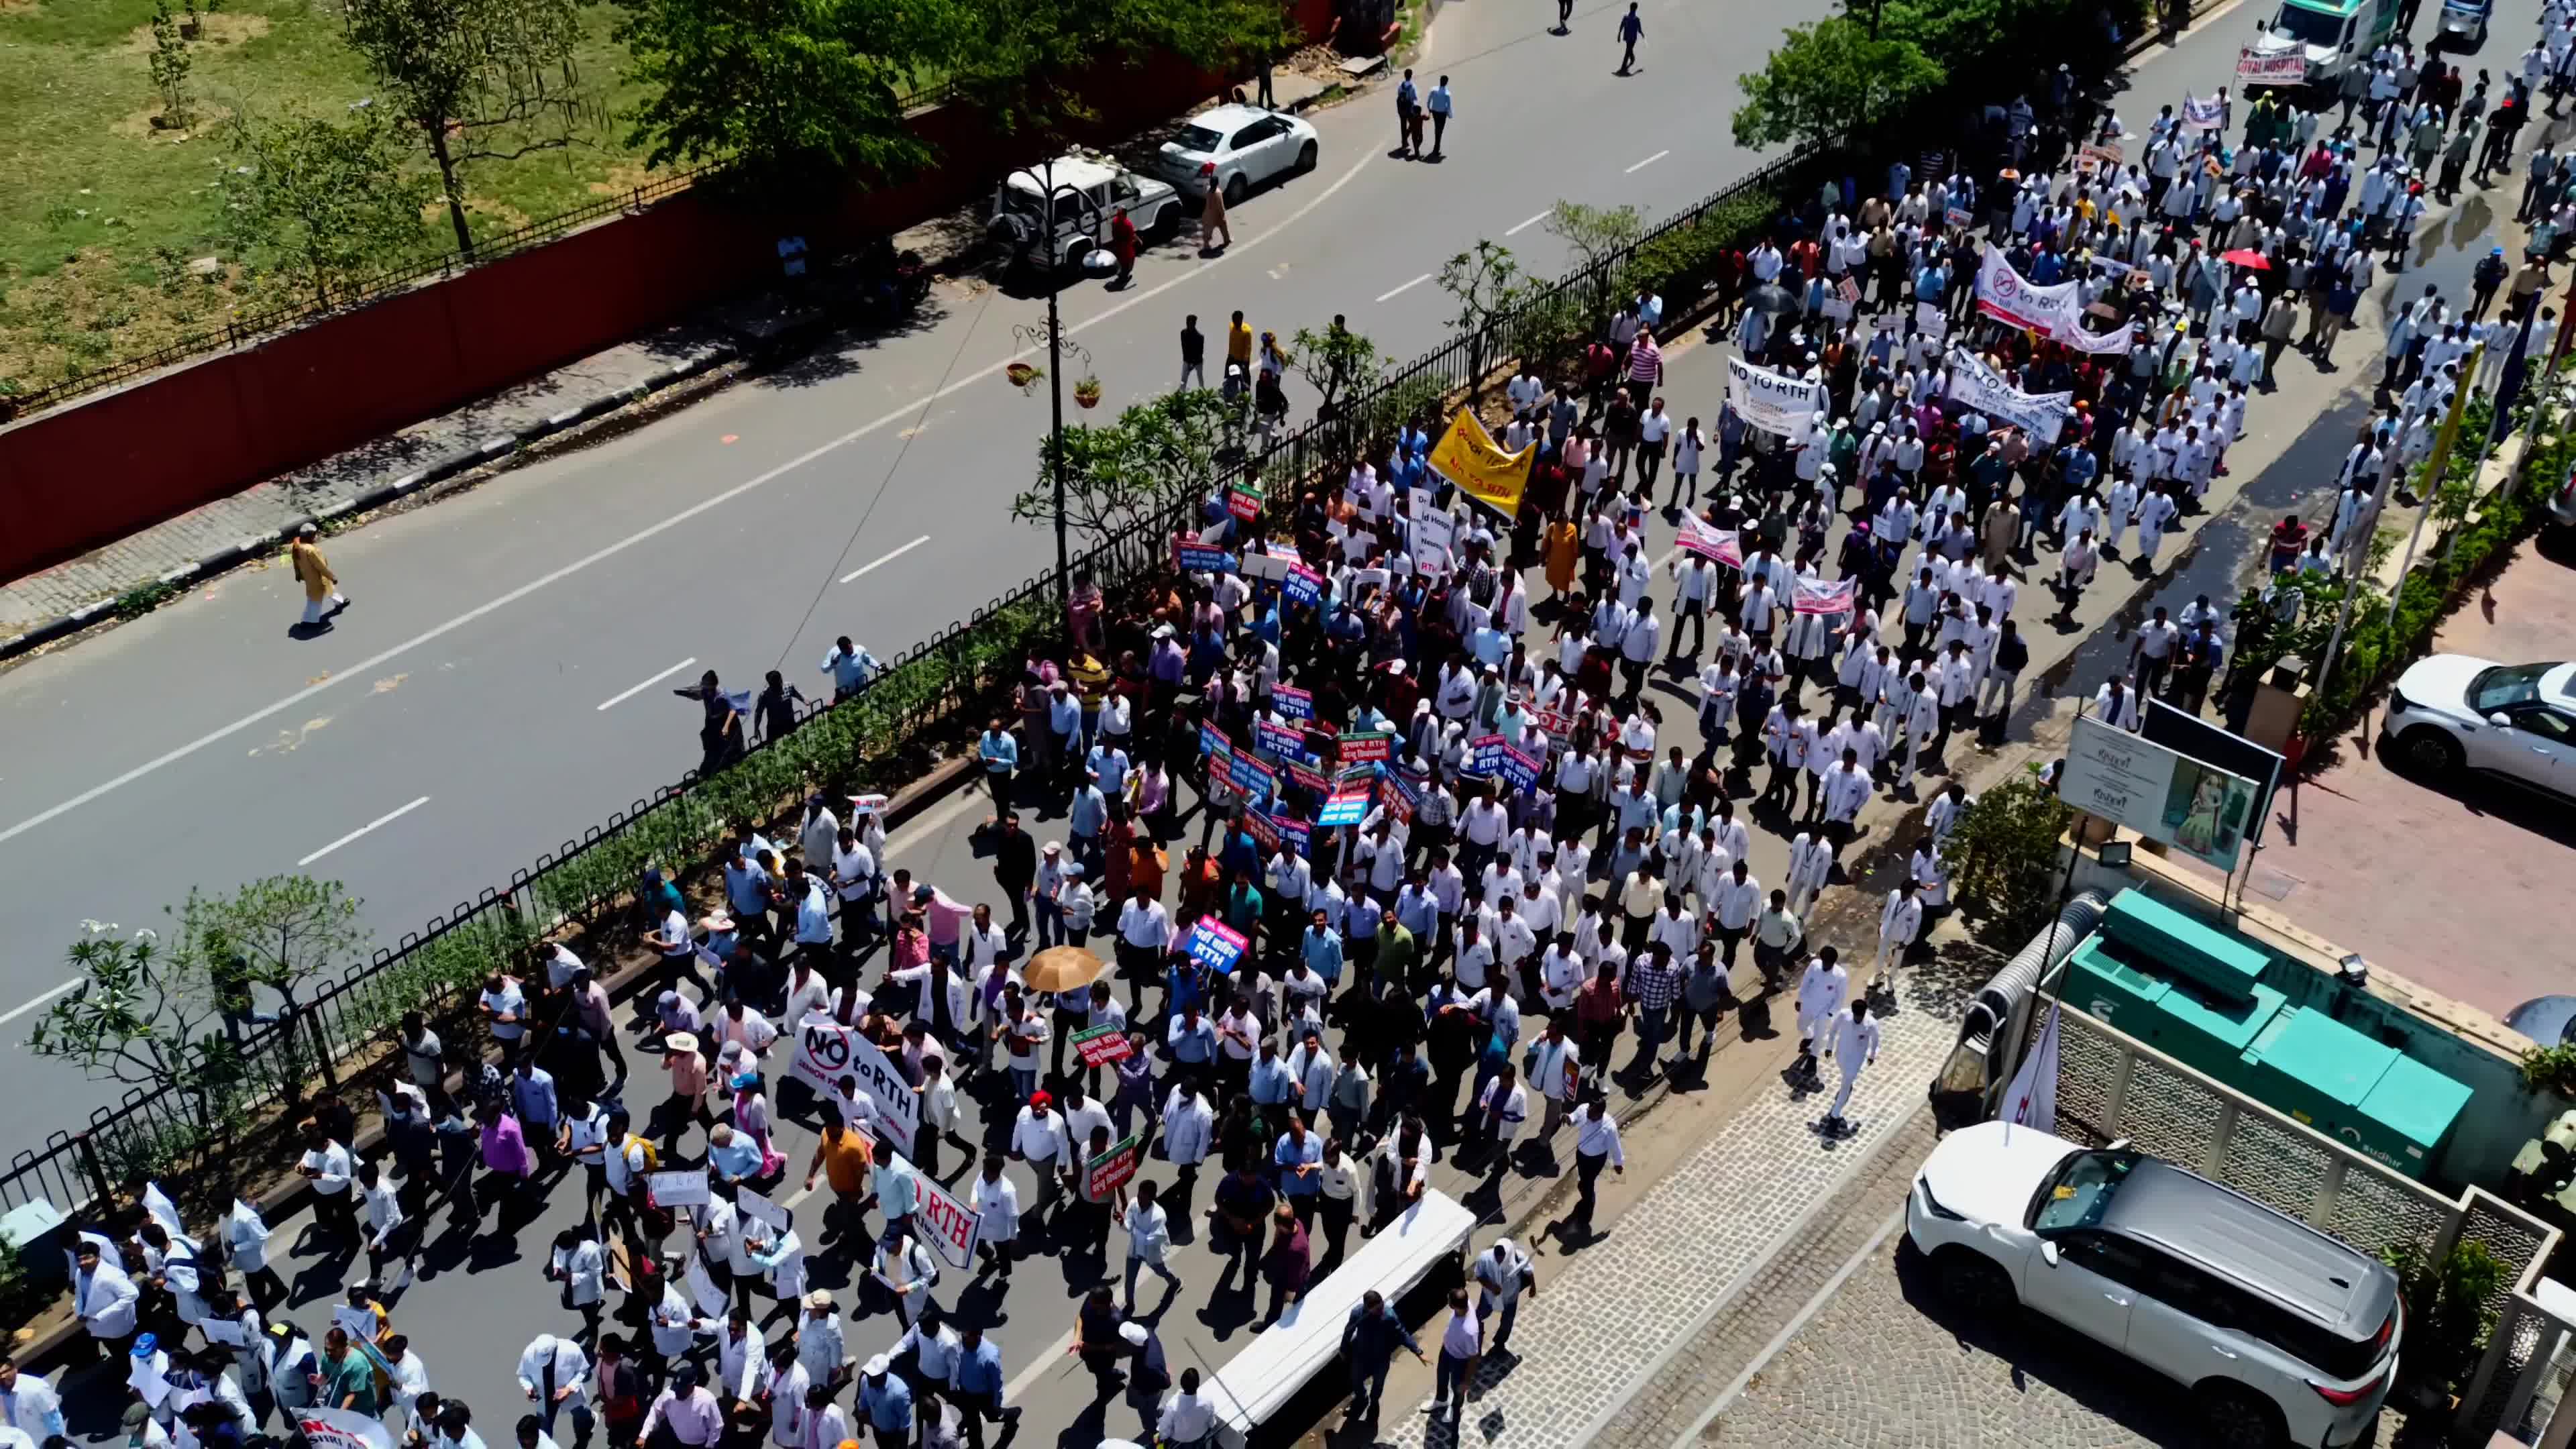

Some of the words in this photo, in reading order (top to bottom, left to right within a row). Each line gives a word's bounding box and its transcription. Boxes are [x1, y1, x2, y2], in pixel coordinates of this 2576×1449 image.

[2264, 57, 2304, 72] HOSPITAL
[1730, 360, 1748, 380] NO
[1753, 374, 1772, 389] TO
[1776, 381, 1809, 402] RTH
[1287, 584, 1309, 601] RTH
[1279, 702, 1305, 716] RTH
[1267, 741, 1293, 757] RTH
[1479, 757, 1499, 769] RTH
[1504, 767, 1528, 788] RTH
[1194, 942, 1225, 967] RTH
[805, 1026, 849, 1064] NO
[853, 1055, 871, 1077] to
[873, 1064, 910, 1120] RTH
[2362, 1144, 2403, 1169] sudhir
[926, 1190, 973, 1250] RTH
